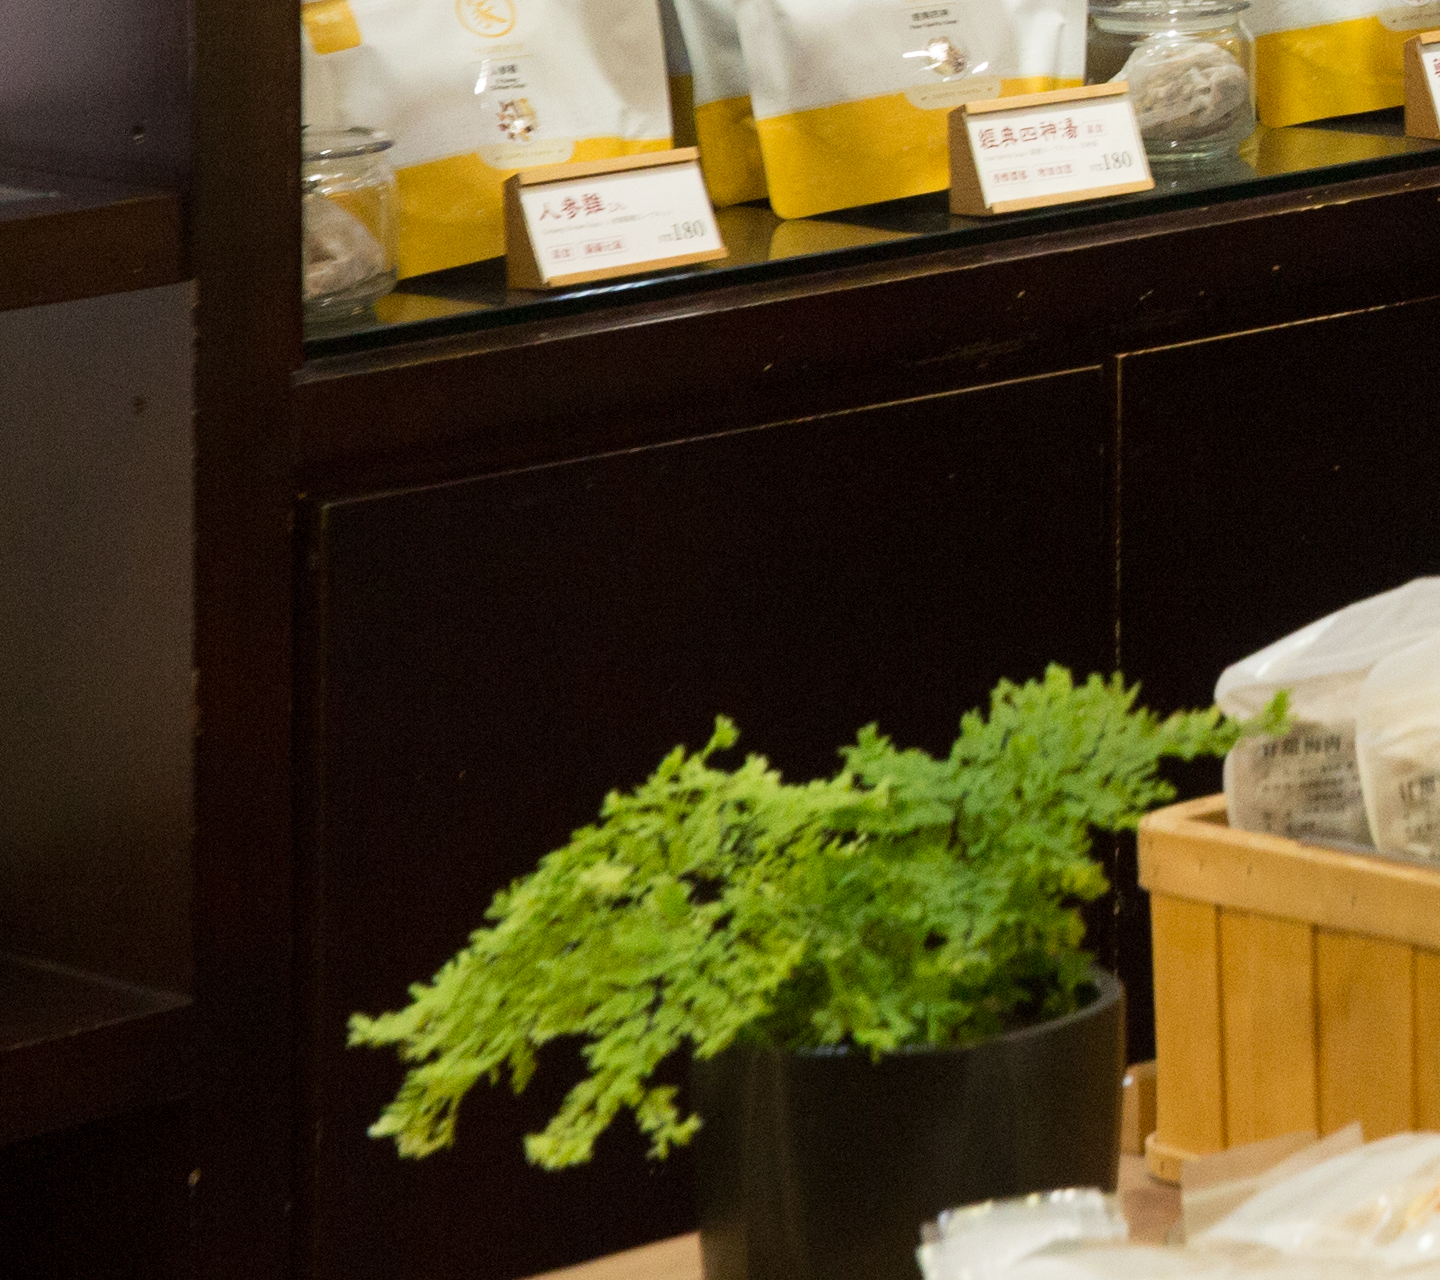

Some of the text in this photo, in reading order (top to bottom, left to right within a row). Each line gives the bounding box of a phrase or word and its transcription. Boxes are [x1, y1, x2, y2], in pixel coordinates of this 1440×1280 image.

[978, 116, 1079, 151] 經典四神湯
[539, 192, 605, 222] 人參雞
